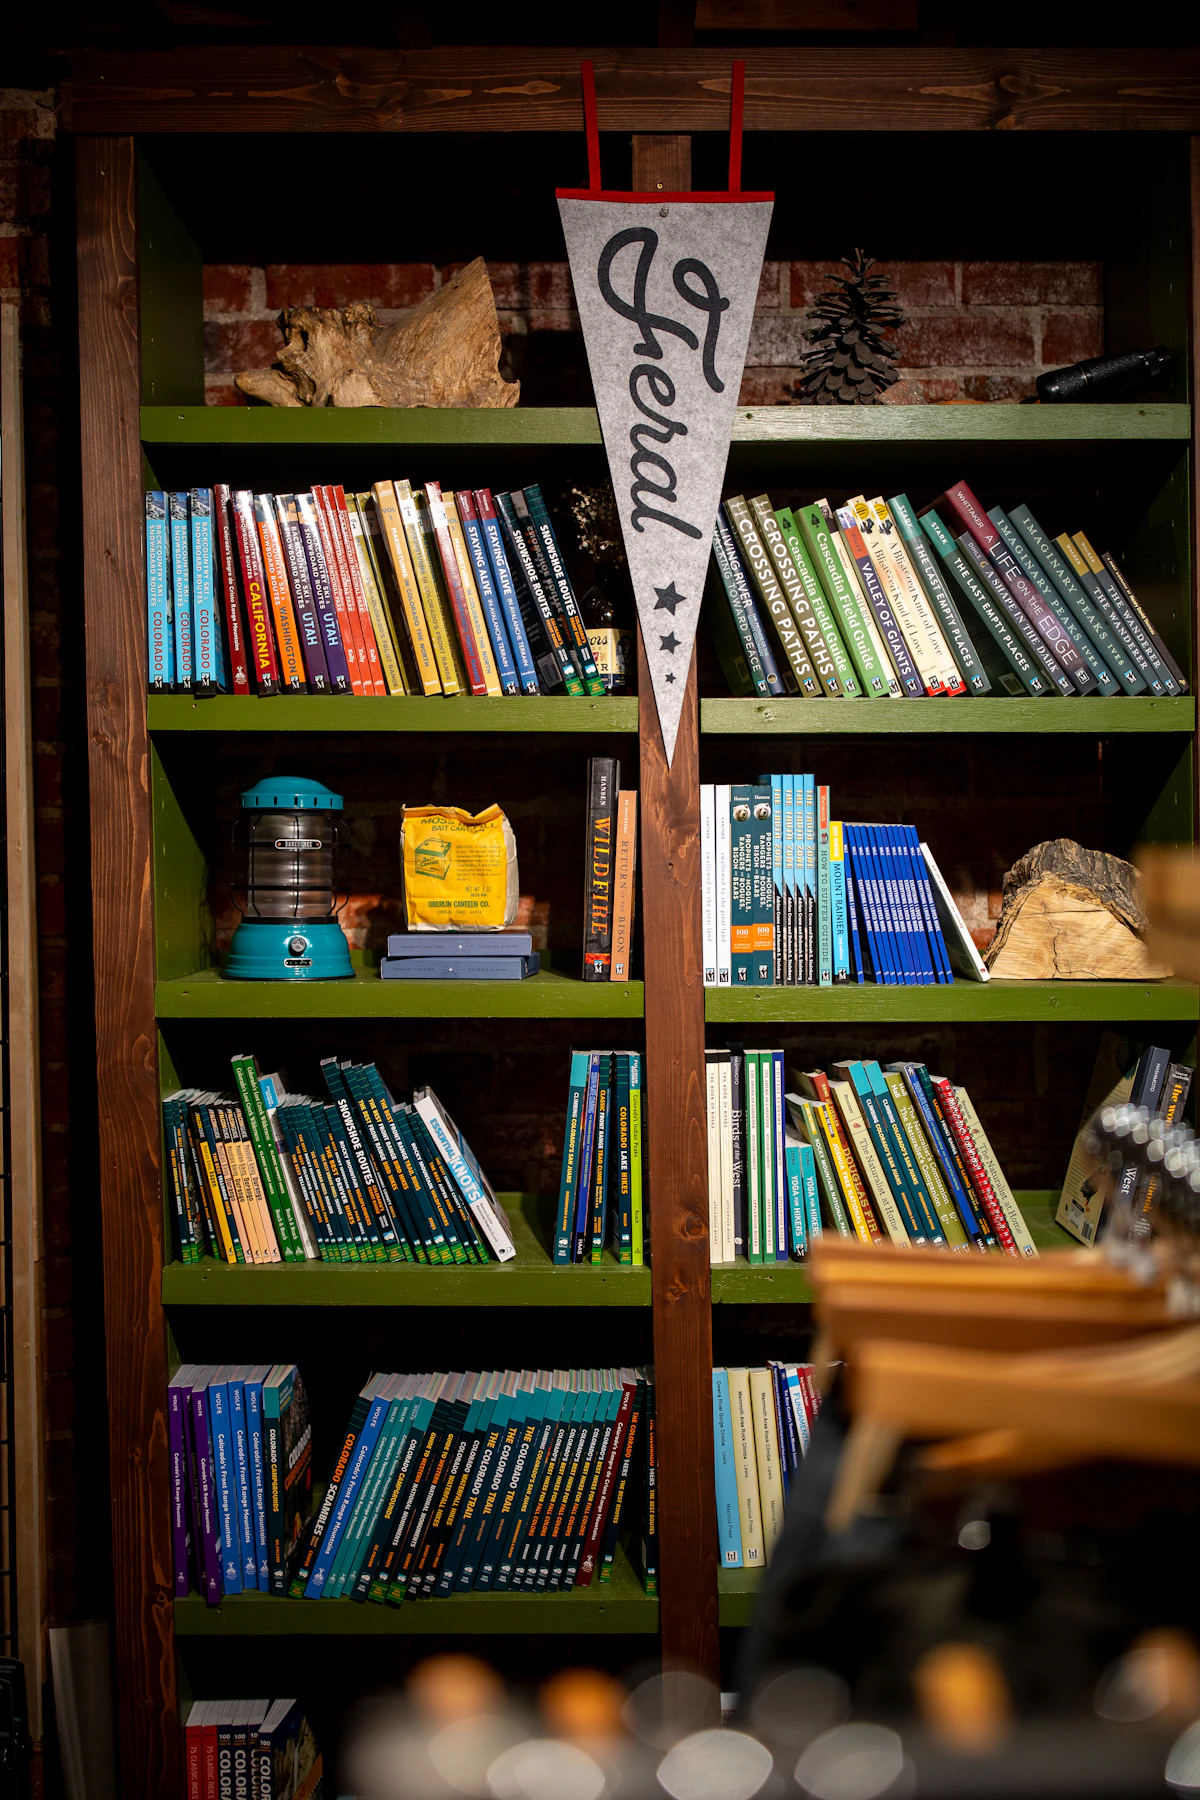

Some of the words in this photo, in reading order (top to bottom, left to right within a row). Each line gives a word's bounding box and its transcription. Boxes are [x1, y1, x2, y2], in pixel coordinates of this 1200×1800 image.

[899, 505, 913, 529] STARK
[957, 491, 984, 528] WHITTAKER
[930, 522, 949, 545] STARK
[968, 542, 982, 560] DIHLE
[985, 535, 994, 543] A
[488, 526, 504, 567] STAYING
[499, 569, 513, 596] ALIVE
[512, 530, 538, 582] SNOWSHOE
[532, 582, 552, 618] ROUTES
[540, 524, 564, 579] SNOWSHOE
[557, 579, 576, 617] ROUTES
[719, 528, 741, 571] LIVING
[733, 570, 753, 608] RIVER
[893, 550, 915, 592] Blistered
[989, 541, 1022, 582] LIFE
[391, 527, 402, 555] MAKING
[398, 554, 409, 578] TURNS
[406, 588, 420, 627] COLORADO
[416, 628, 424, 642] THE
[420, 643, 430, 667] NORTH
[468, 526, 485, 567] STAYING
[479, 569, 492, 596] ALIVE
[490, 606, 503, 642] AVALANCHE
[498, 642, 509, 668] TERRAIN
[739, 519, 786, 615] CROSSING
[777, 617, 811, 676] PATHS
[763, 518, 810, 614] CROSSING
[801, 616, 834, 676] PATHS
[788, 536, 817, 597] Cascadia
[811, 596, 833, 632] Field
[825, 629, 847, 673] Guide
[817, 533, 845, 594] Cascadia
[839, 594, 860, 629] Field
[852, 629, 874, 671] Guide
[911, 592, 928, 619] Kind
[915, 543, 929, 565] THE
[924, 564, 941, 591] LAST
[936, 592, 957, 626] EMPTY
[952, 628, 974, 668] PLACES
[997, 519, 1052, 595] IMAGINARY
[1050, 599, 1082, 642] PEAKS
[1081, 645, 1099, 667] IVES
[1017, 580, 1031, 596] ON
[1022, 518, 1078, 594] IMAGINARY
[1076, 598, 1108, 640] PEAKS
[1107, 643, 1125, 666] IVES
[1028, 595, 1044, 616] THE
[250, 582, 270, 669] CALIFORNIA
[302, 612, 318, 646] UTAH
[323, 613, 338, 646] UTAH
[727, 584, 749, 632] TOWARD
[743, 635, 762, 672] PEACE
[862, 562, 886, 607] VALLEY
[880, 610, 894, 627] OF
[887, 629, 912, 676] GIANTS
[922, 619, 935, 630] of
[954, 557, 970, 578] THE
[967, 578, 986, 602] LAST
[982, 602, 1006, 634] EMPTY
[1003, 635, 1030, 671] PLACES
[985, 570, 994, 579] A
[991, 578, 1017, 611] SHAPE
[1014, 611, 1026, 624] IN
[1023, 623, 1040, 646] THE
[1037, 645, 1059, 673] DARK
[1092, 587, 1111, 611] THE
[1109, 612, 1149, 670] WANDERER
[1108, 585, 1125, 609] THE
[1122, 610, 1161, 669] WANDERER
[153, 611, 163, 671] COLORADO
[180, 612, 191, 671] COLORADO
[199, 609, 210, 669] COLORADO
[279, 606, 298, 673] WASHINGTON
[928, 631, 943, 657] Love
[1039, 615, 1078, 666] EDGE
[599, 776, 607, 806] HANSEN
[773, 788, 781, 806] THE
[773, 810, 781, 840] TRUTH
[591, 816, 611, 935] WILDFIRE
[619, 840, 629, 889] RETURN
[774, 843, 782, 869] ZONE
[822, 872, 828, 885] TO
[833, 863, 842, 898] MOUNT
[616, 916, 626, 953] BISON
[835, 899, 844, 935] RAINIER
[337, 1098, 362, 1150] SNOWSHOE
[355, 1150, 374, 1186] ROUTES
[619, 1106, 628, 1149] COLORADO
[732, 1110, 742, 1141] Birds
[429, 1117, 456, 1160] ESSENTIAL
[450, 1156, 481, 1202] KNOTS
[620, 1151, 628, 1170] LAKE
[733, 1160, 742, 1189] West
[900, 1106, 909, 1122] The
[905, 1122, 926, 1165] Naturalist's
[921, 1164, 942, 1208] Companion
[620, 1172, 628, 1195] HIKES
[791, 1175, 799, 1197] YOGA
[814, 1138, 824, 1159] ROCKY
[821, 1158, 835, 1191] MOUNTAIN
[830, 1191, 842, 1222] NATIONAL
[839, 1220, 849, 1238] PARK
[832, 1143, 845, 1170] JOSHUA
[842, 1170, 850, 1189] TREE
[847, 1189, 861, 1225] NATIONAL
[858, 1225, 868, 1243] PARK
[843, 1147, 869, 1207] DOUGLAS
[864, 1210, 878, 1233] FIR
[859, 1137, 870, 1156] The
[865, 1155, 886, 1200] Naturalist
[885, 1204, 899, 1231] Home
[794, 1208, 803, 1236] HIKERS
[217, 1433, 226, 1470] Colorado's
[269, 1428, 277, 1463] COLORADO
[487, 1431, 499, 1449] THE
[505, 1427, 518, 1445] THE
[523, 1425, 535, 1443] THE
[332, 1433, 356, 1483] COLORADO
[471, 1449, 493, 1495] COLORADO
[491, 1444, 512, 1491] COLORADO
[509, 1442, 530, 1489] COLORADO
[270, 1463, 279, 1513] CAMPGROUNDS
[313, 1483, 338, 1537] SCRAMBLES
[462, 1496, 478, 1519] TRAIL
[482, 1492, 497, 1515] TRAIL
[501, 1491, 516, 1514] TRAIL
